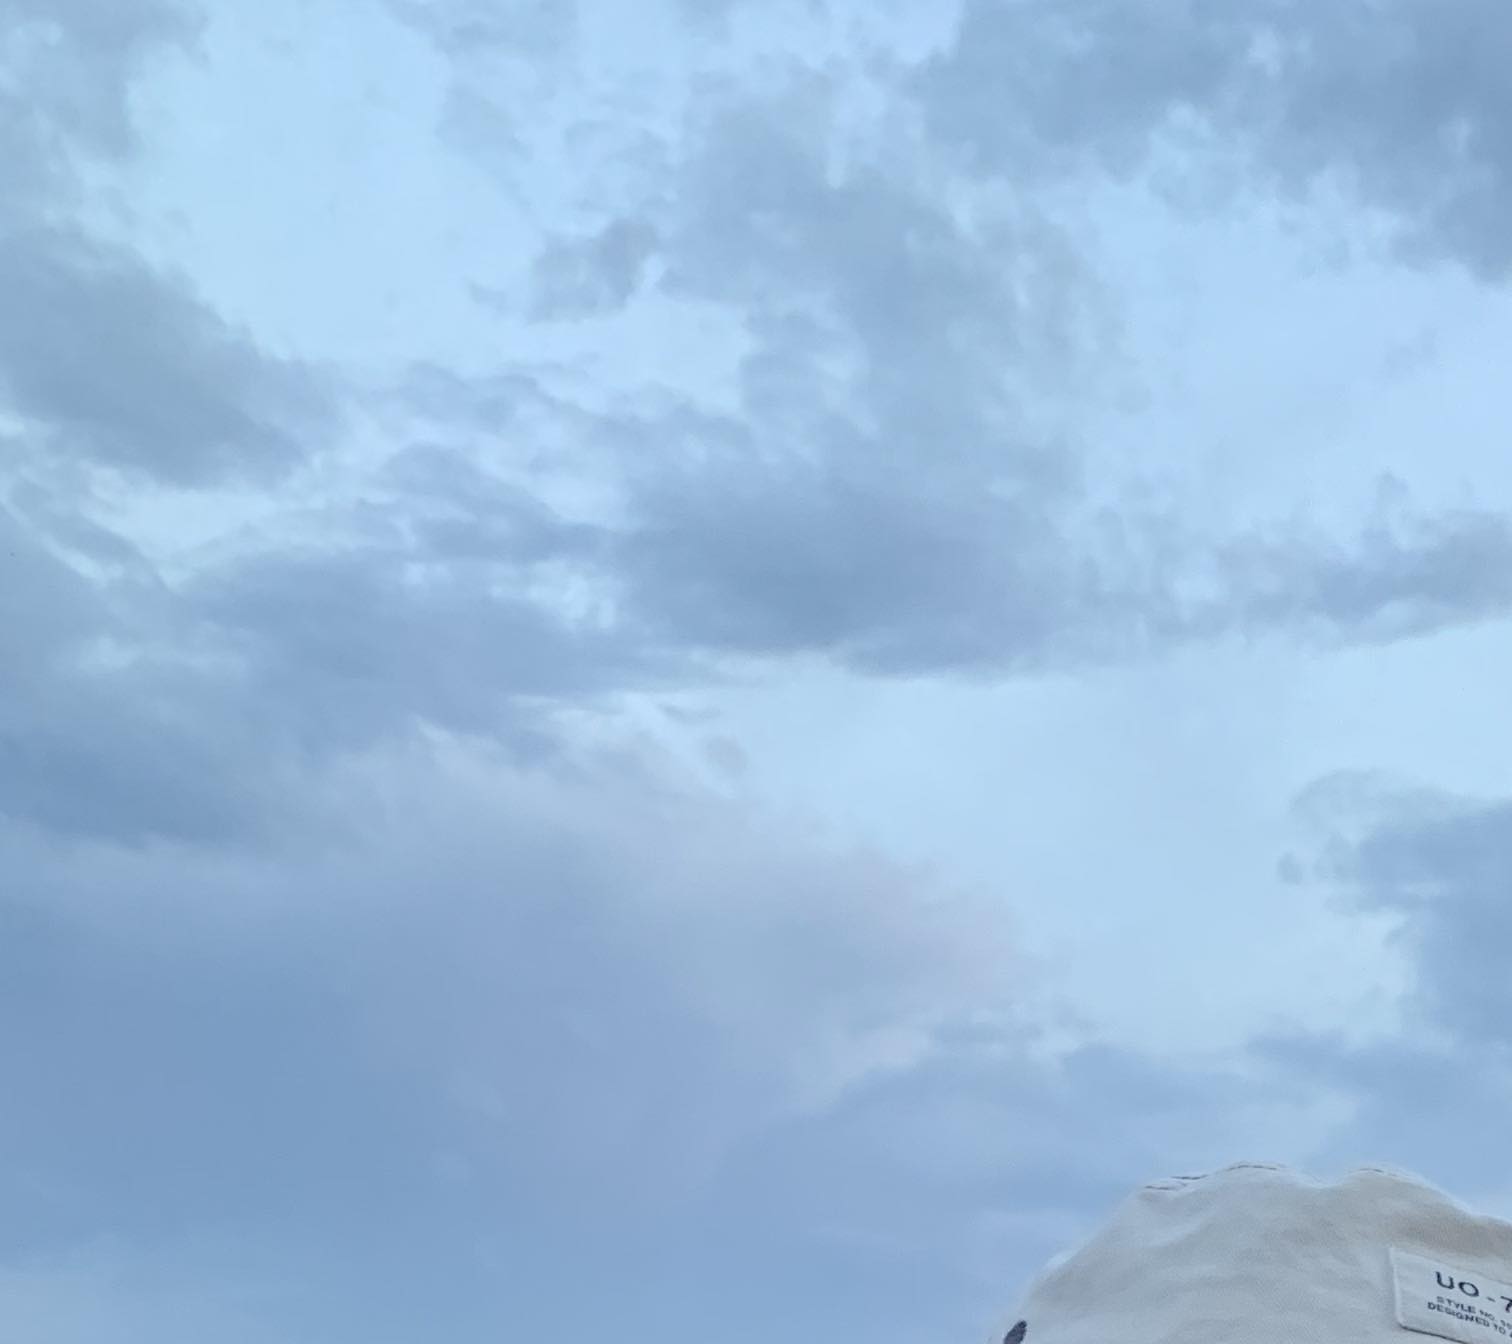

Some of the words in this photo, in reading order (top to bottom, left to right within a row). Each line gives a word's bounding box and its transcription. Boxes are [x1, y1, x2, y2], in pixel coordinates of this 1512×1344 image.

[1436, 1295, 1476, 1314] STYLE
[1427, 1301, 1490, 1327] DESIGNED
[1493, 1323, 1506, 1335] TO
